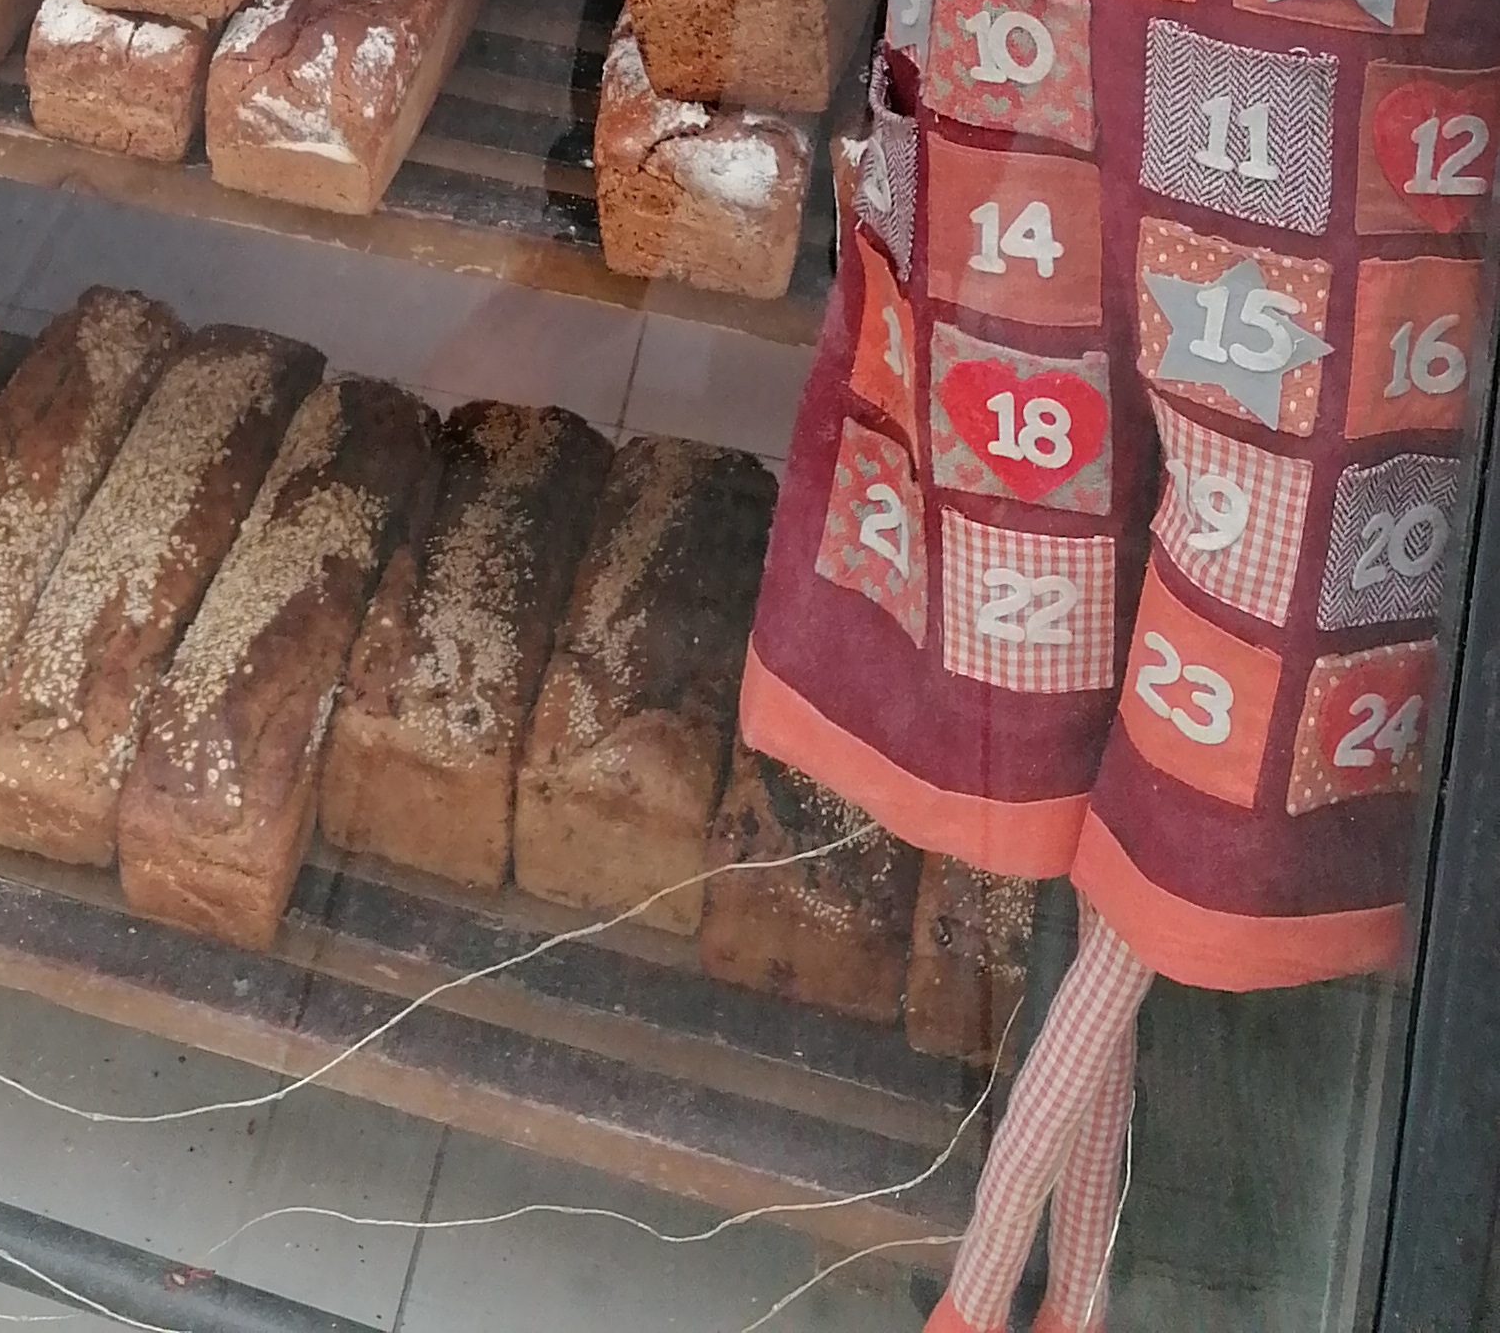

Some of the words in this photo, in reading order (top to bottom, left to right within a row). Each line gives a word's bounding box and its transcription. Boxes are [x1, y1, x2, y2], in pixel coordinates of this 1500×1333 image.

[963, 11, 1056, 85] 10
[1195, 96, 1277, 181] 11
[1404, 114, 1490, 196] 12
[968, 201, 1064, 277] 14
[1189, 286, 1302, 373] 15
[1384, 314, 1467, 399] 16
[986, 391, 1073, 469] 18
[1350, 505, 1447, 590] 20
[975, 567, 1078, 645] 22
[1136, 632, 1234, 744] 23
[1334, 693, 1422, 766] 24
